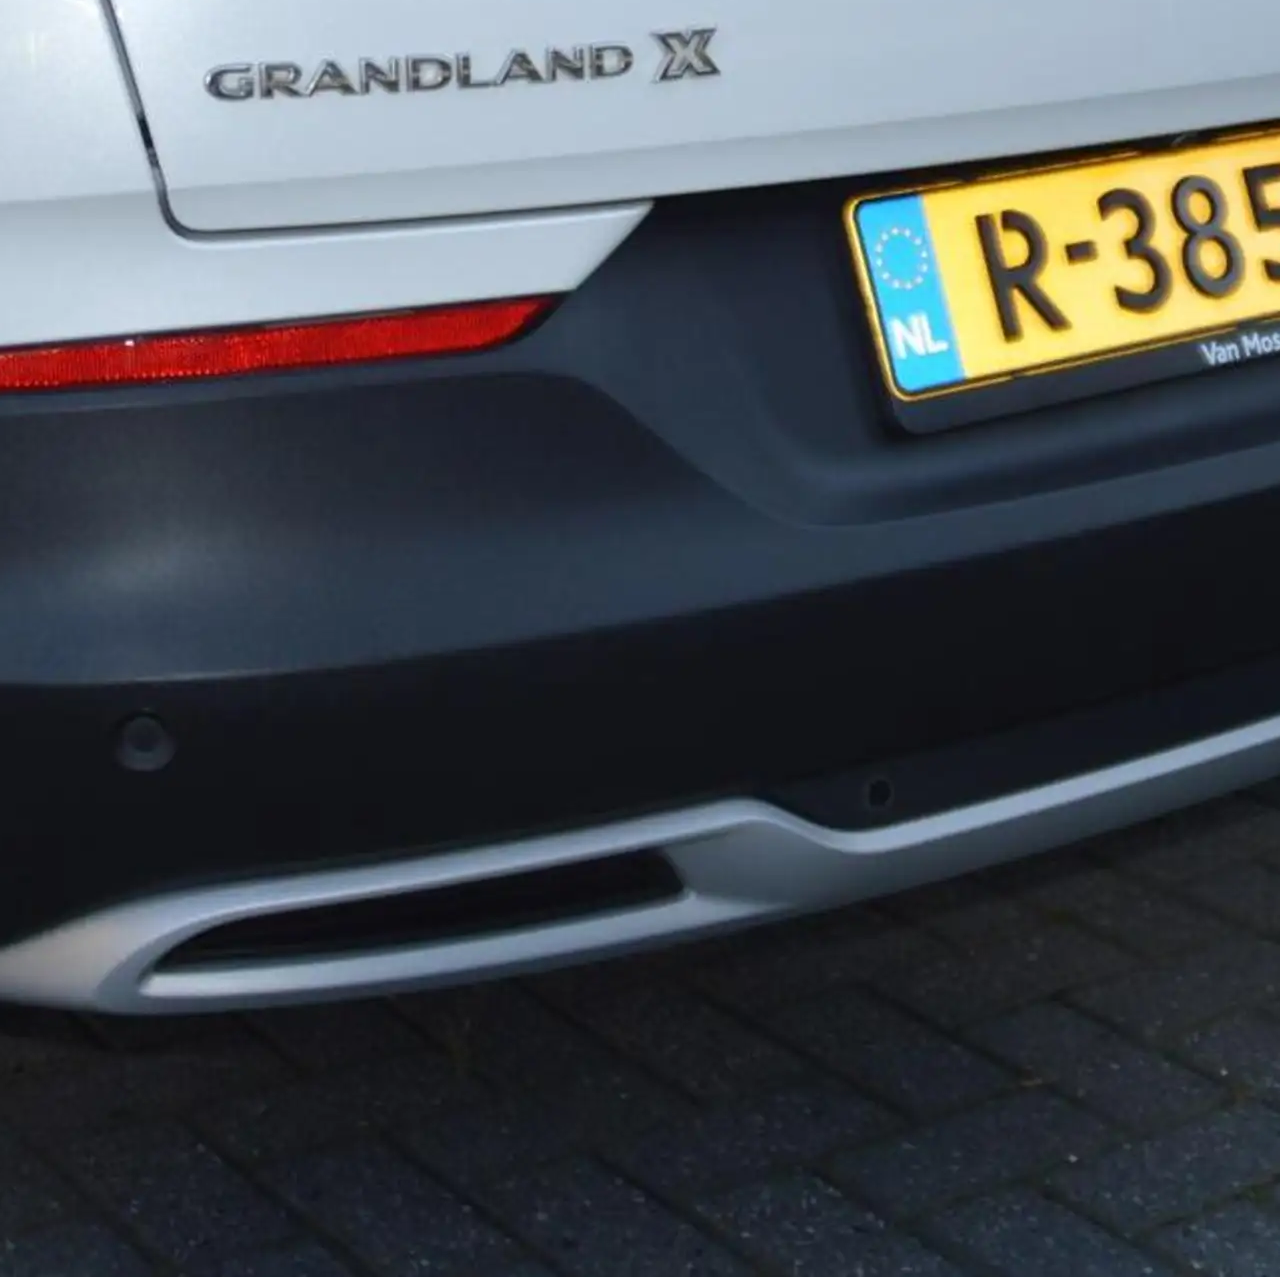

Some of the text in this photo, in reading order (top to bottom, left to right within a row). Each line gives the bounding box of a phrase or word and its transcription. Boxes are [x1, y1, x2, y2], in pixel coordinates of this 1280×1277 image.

[203, 27, 722, 101] GRANDLAND X
[887, 312, 948, 360] NL
[1200, 341, 1240, 366] Van
